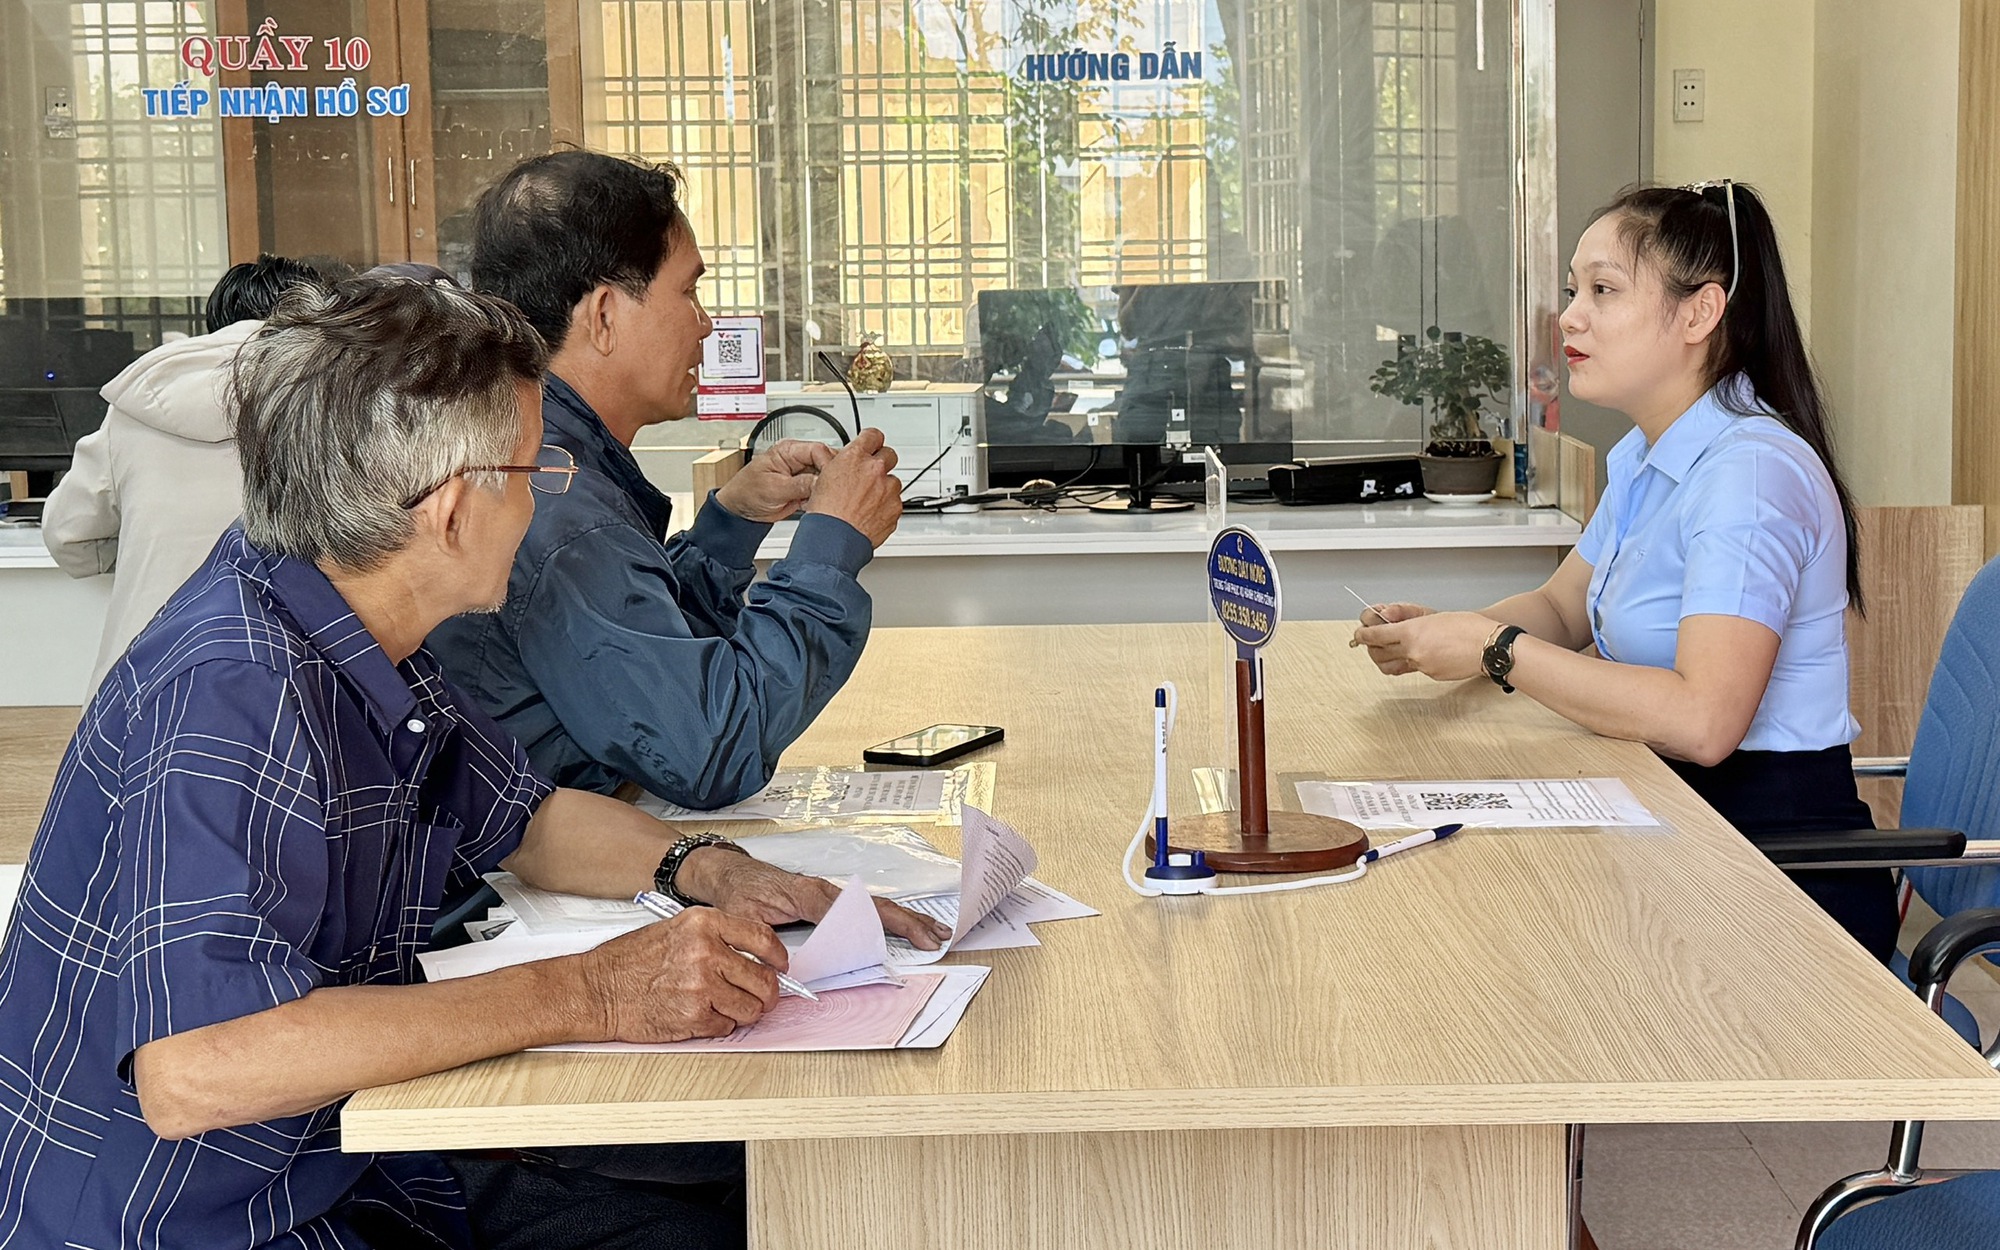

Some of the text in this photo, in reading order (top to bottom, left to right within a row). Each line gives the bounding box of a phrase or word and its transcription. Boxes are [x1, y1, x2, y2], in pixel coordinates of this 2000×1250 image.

[181, 17, 371, 77] QUẦY 10
[1026, 41, 1203, 81] HƯỚNG DẪN
[141, 77, 411, 123] TIẾP NHẬN HỒ SƠ
